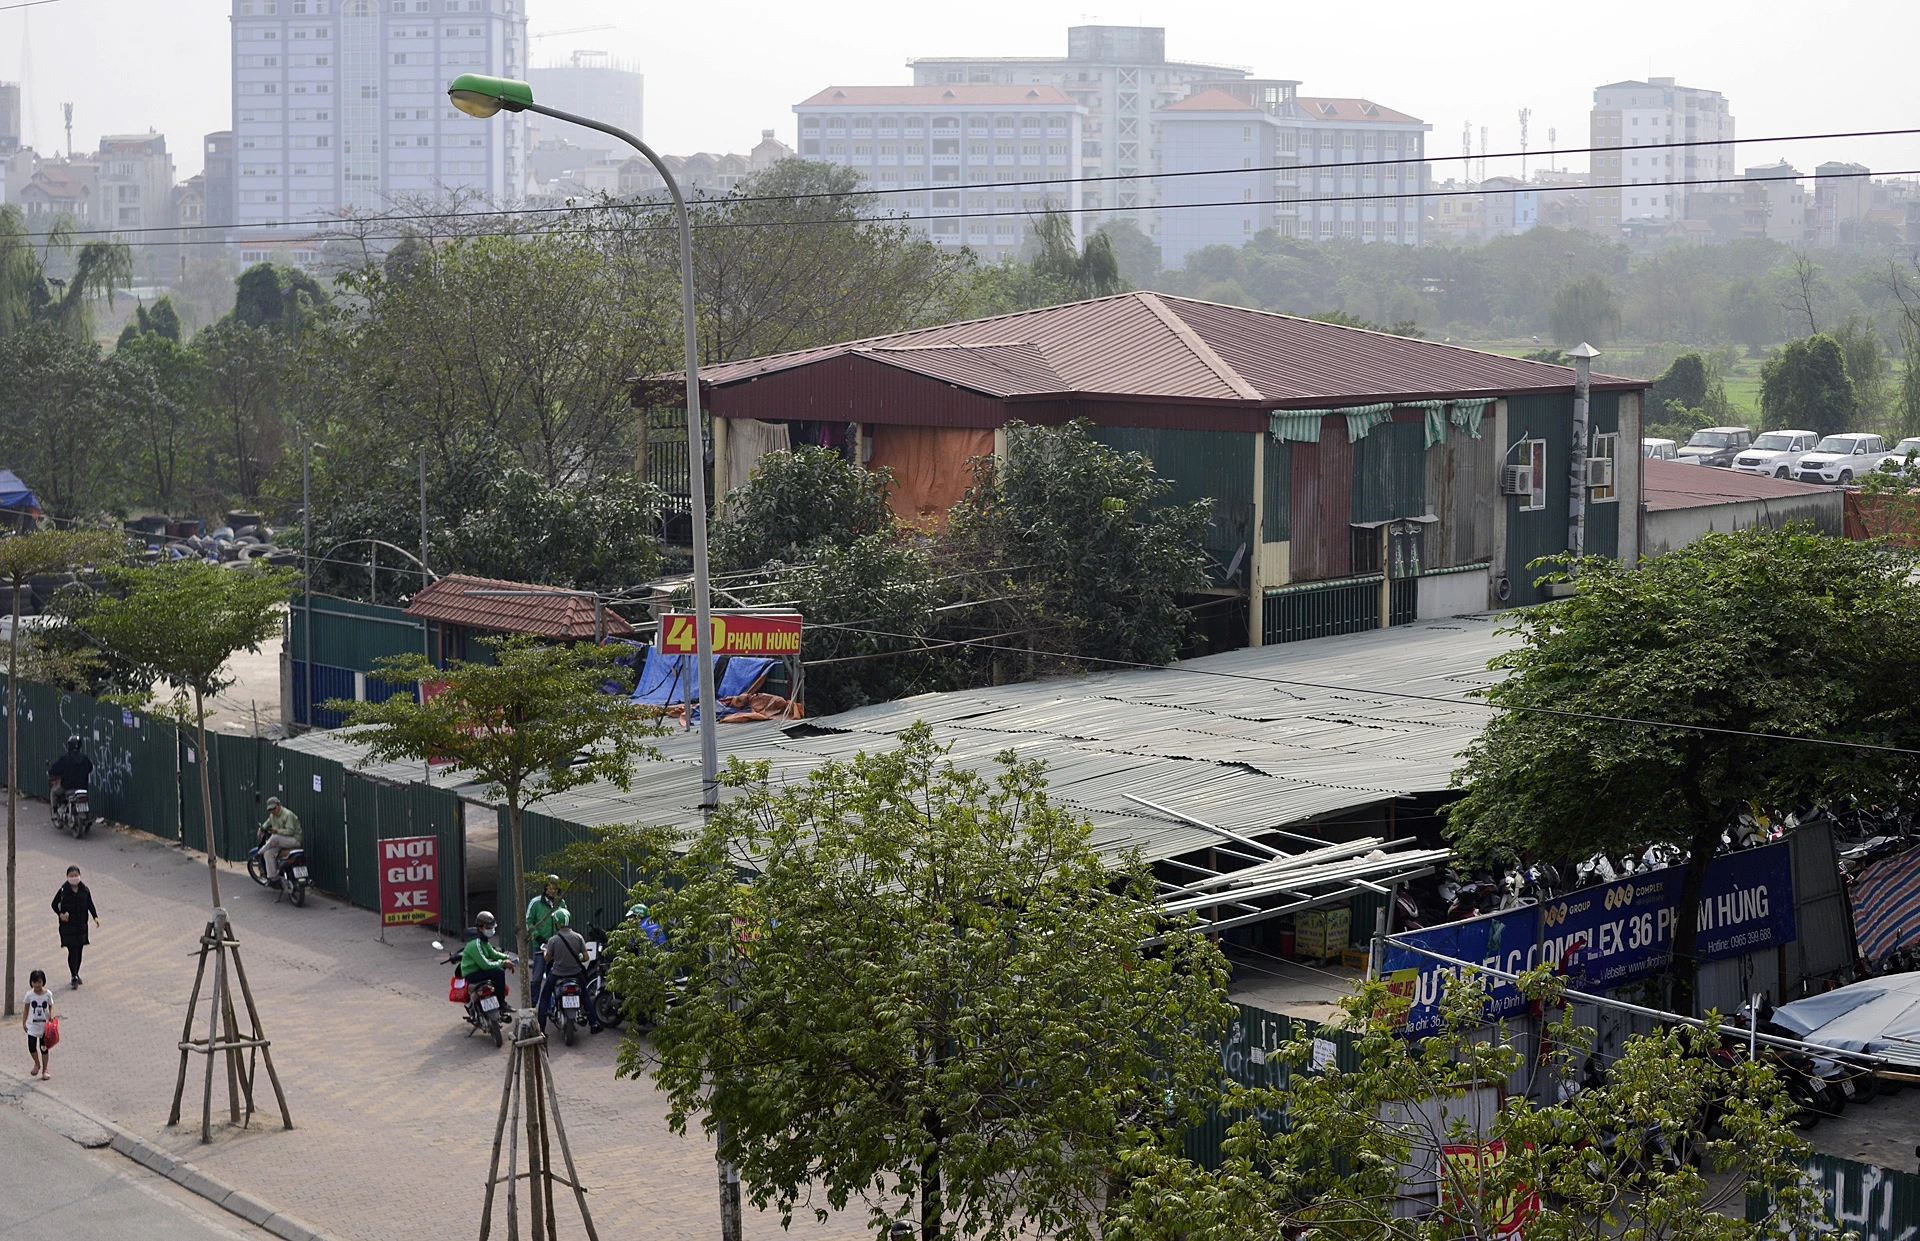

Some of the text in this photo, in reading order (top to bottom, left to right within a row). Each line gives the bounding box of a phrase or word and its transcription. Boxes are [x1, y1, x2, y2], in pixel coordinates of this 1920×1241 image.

[727, 632, 763, 653] PHẠM
[766, 628, 799, 650] HÙNG
[385, 840, 434, 859] NƠI
[387, 860, 434, 883] GỬI
[393, 890, 429, 908] XE
[1636, 882, 1664, 897] COMPLEX
[1569, 901, 1591, 915] GROUP
[1481, 950, 1521, 991] FLC
[1629, 913, 1653, 949] 36
[1657, 897, 1713, 942] PHM
[1718, 884, 1769, 928] HÙNG
[1707, 939, 1730, 954] Hotline:
[1730, 933, 1747, 948] 0965
[1430, 1014, 1441, 1028] 36
